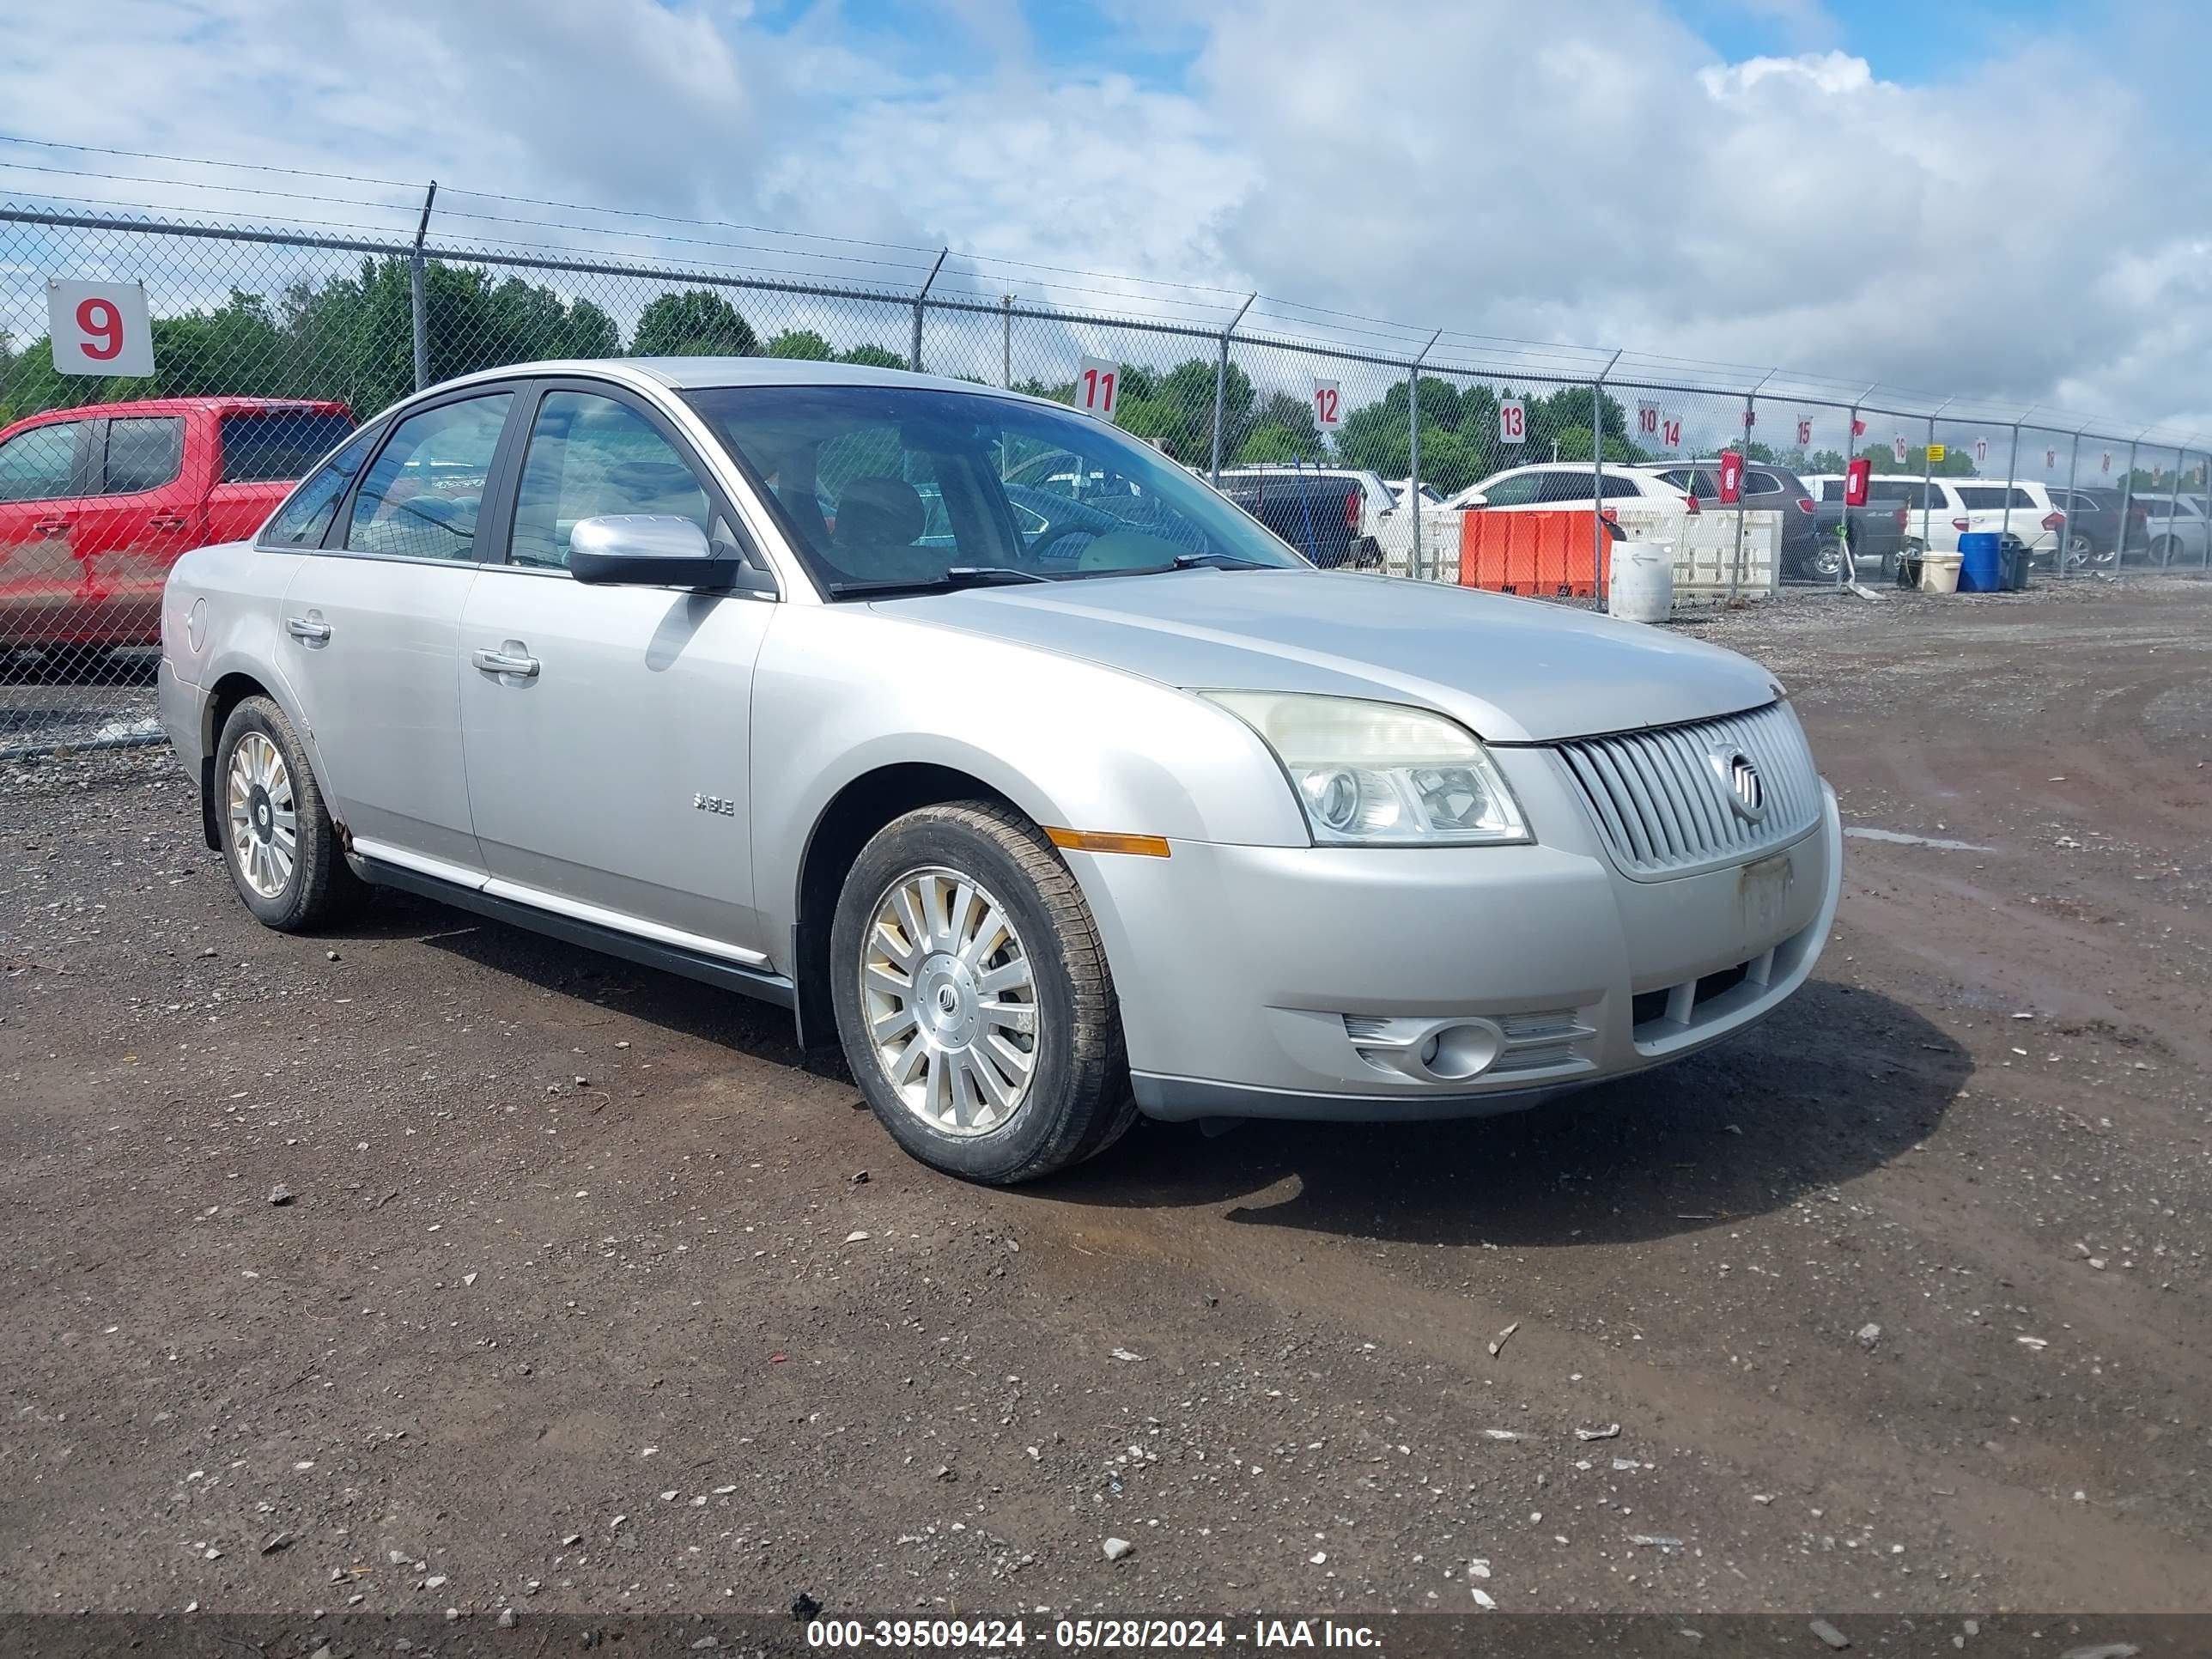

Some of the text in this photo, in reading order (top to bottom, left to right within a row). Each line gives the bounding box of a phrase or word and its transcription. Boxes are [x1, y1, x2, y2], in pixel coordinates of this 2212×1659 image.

[76, 297, 124, 361] 9
[1084, 368, 1115, 412] 11
[1316, 389, 1338, 422] 12
[1502, 407, 1523, 436] 13
[1639, 409, 1656, 433] 10
[1663, 420, 1680, 447] 14
[1798, 421, 1810, 445] 15
[1895, 438, 1905, 459] 16
[1977, 441, 1987, 461] 17
[693, 793, 735, 817] SABLE
